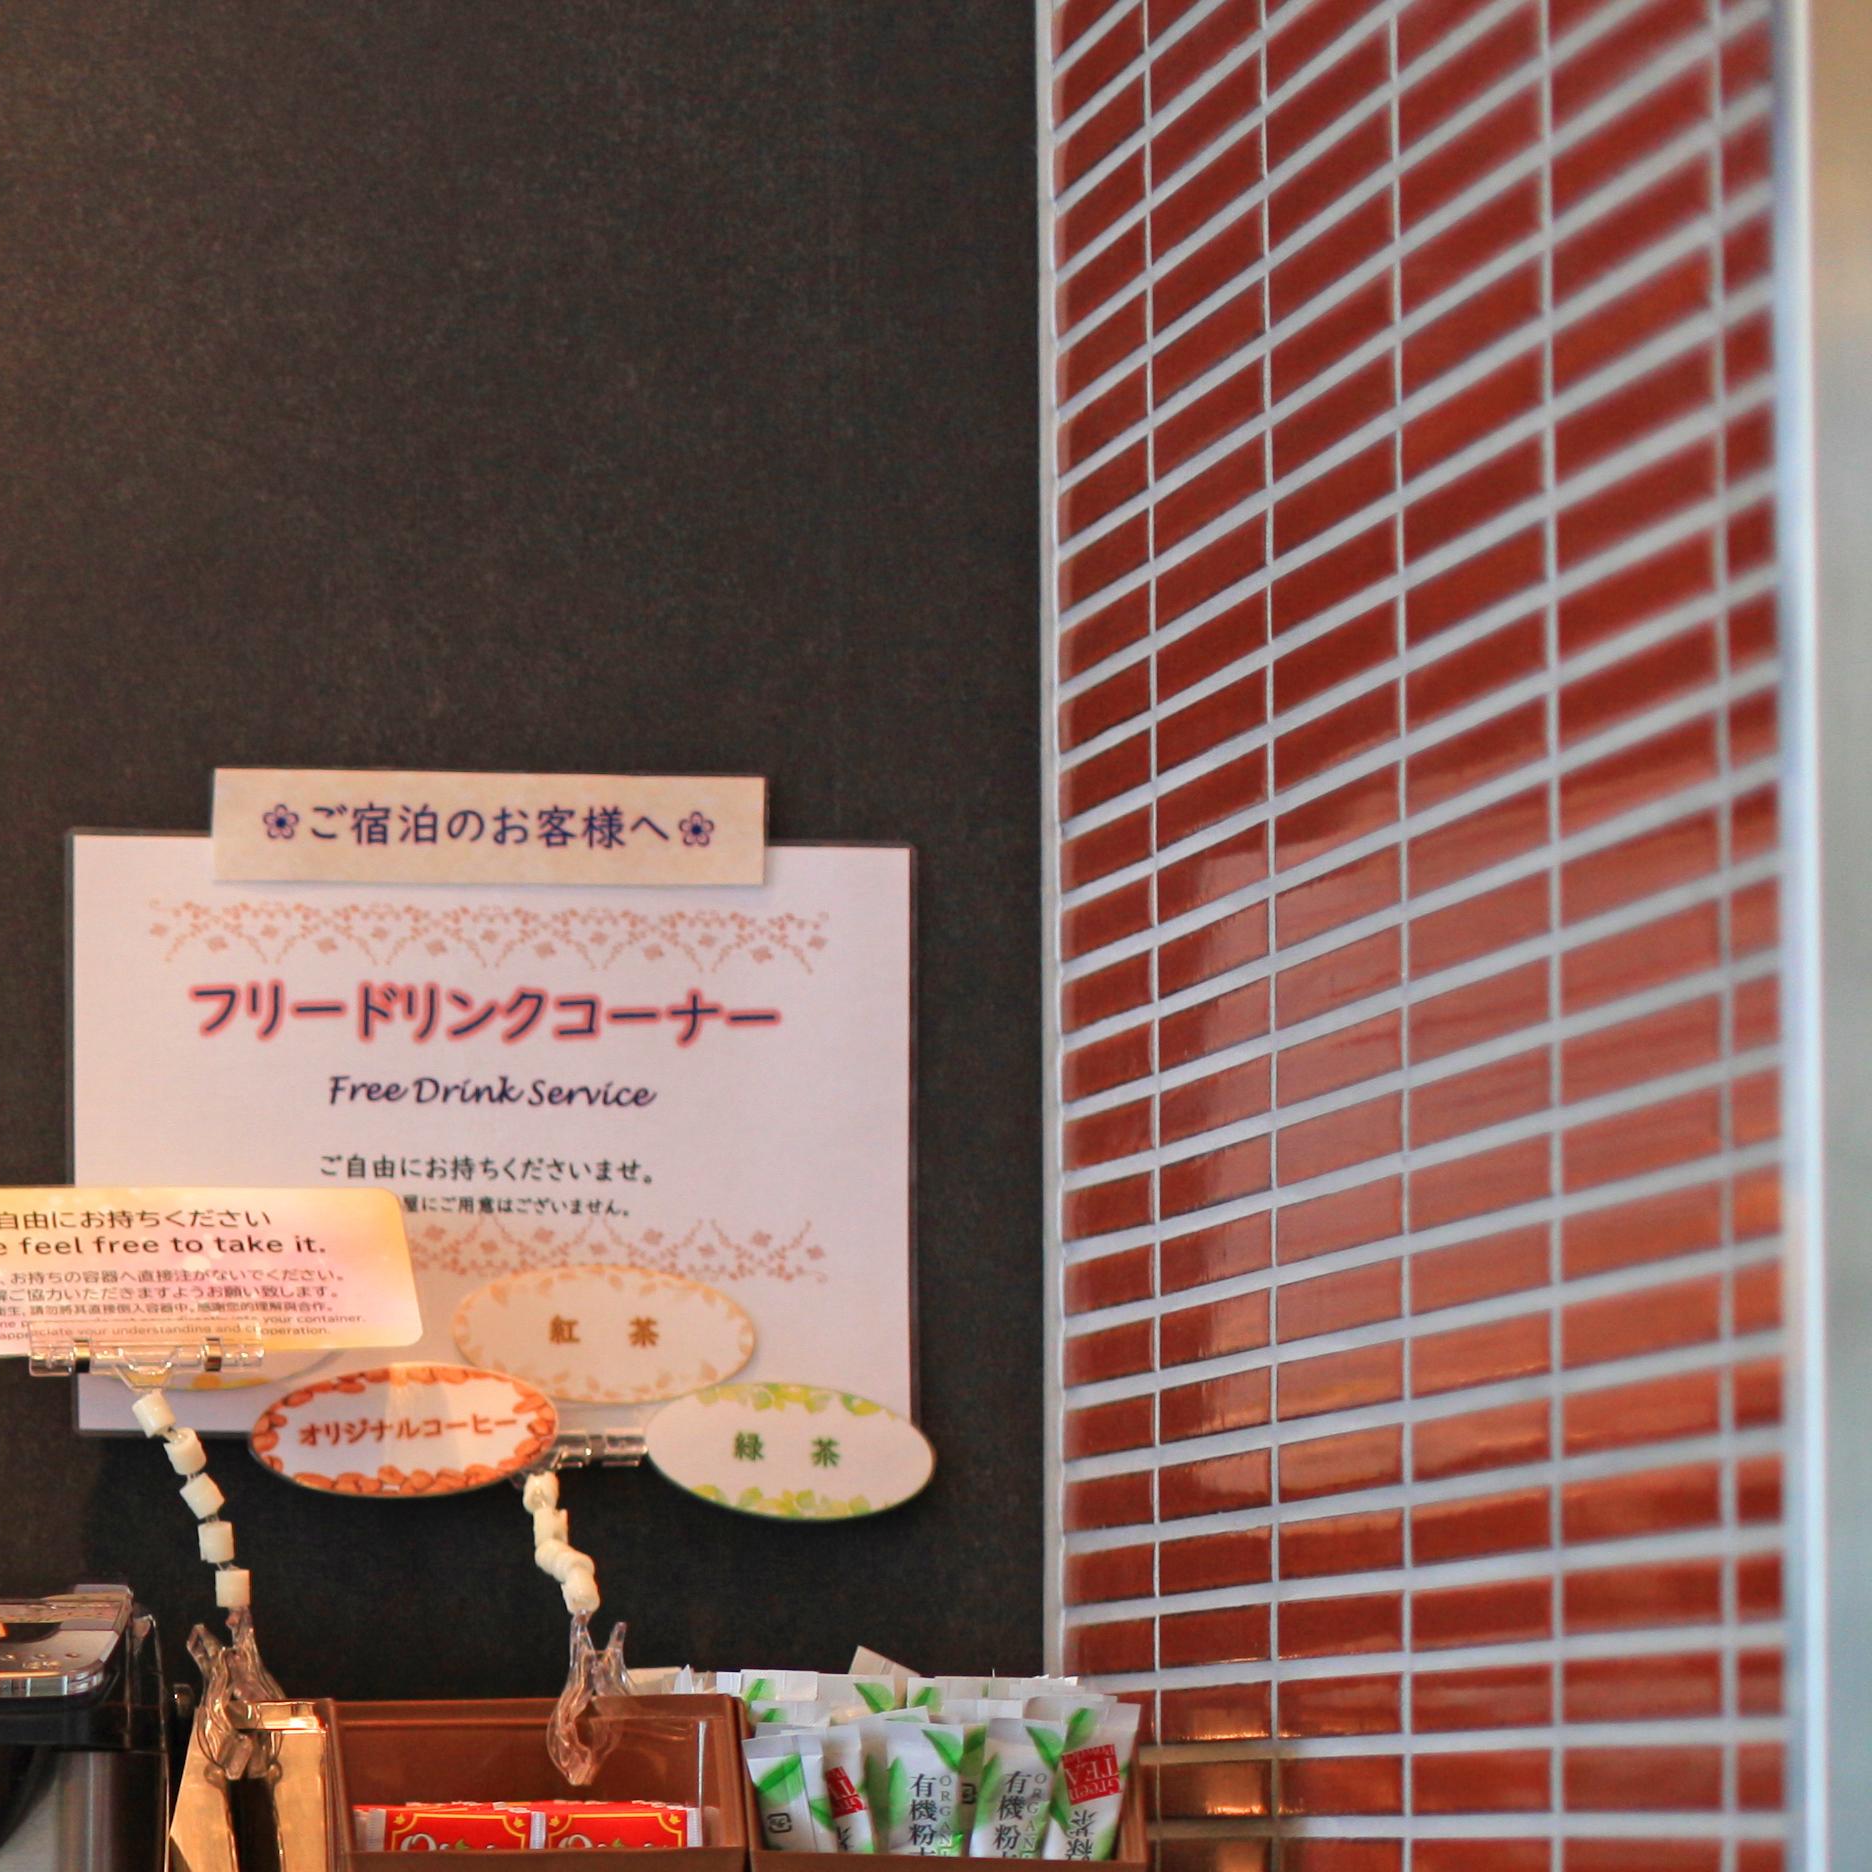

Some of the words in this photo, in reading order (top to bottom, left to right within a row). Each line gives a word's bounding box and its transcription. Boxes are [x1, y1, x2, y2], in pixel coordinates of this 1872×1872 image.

[310, 802, 671, 850] ご宿泊のお客様へ
[188, 978, 782, 1048] フリードリンクコーナー
[328, 1075, 409, 1106] Free
[412, 1076, 524, 1104] Drink
[527, 1078, 658, 1108] Service
[319, 1153, 654, 1185] ご自由にお持ちくださいませ。
[21, 1236, 83, 1255] feel
[92, 1236, 159, 1254] free
[170, 1237, 203, 1253] to
[215, 1235, 283, 1253] take
[295, 1235, 326, 1253] it.
[260, 1314, 293, 1325] your
[549, 1317, 660, 1347] 紅茶
[297, 1412, 520, 1446] オリジナルコーヒー
[731, 1431, 842, 1469] 緑茶
[992, 1770, 1032, 1858] 有機粉
